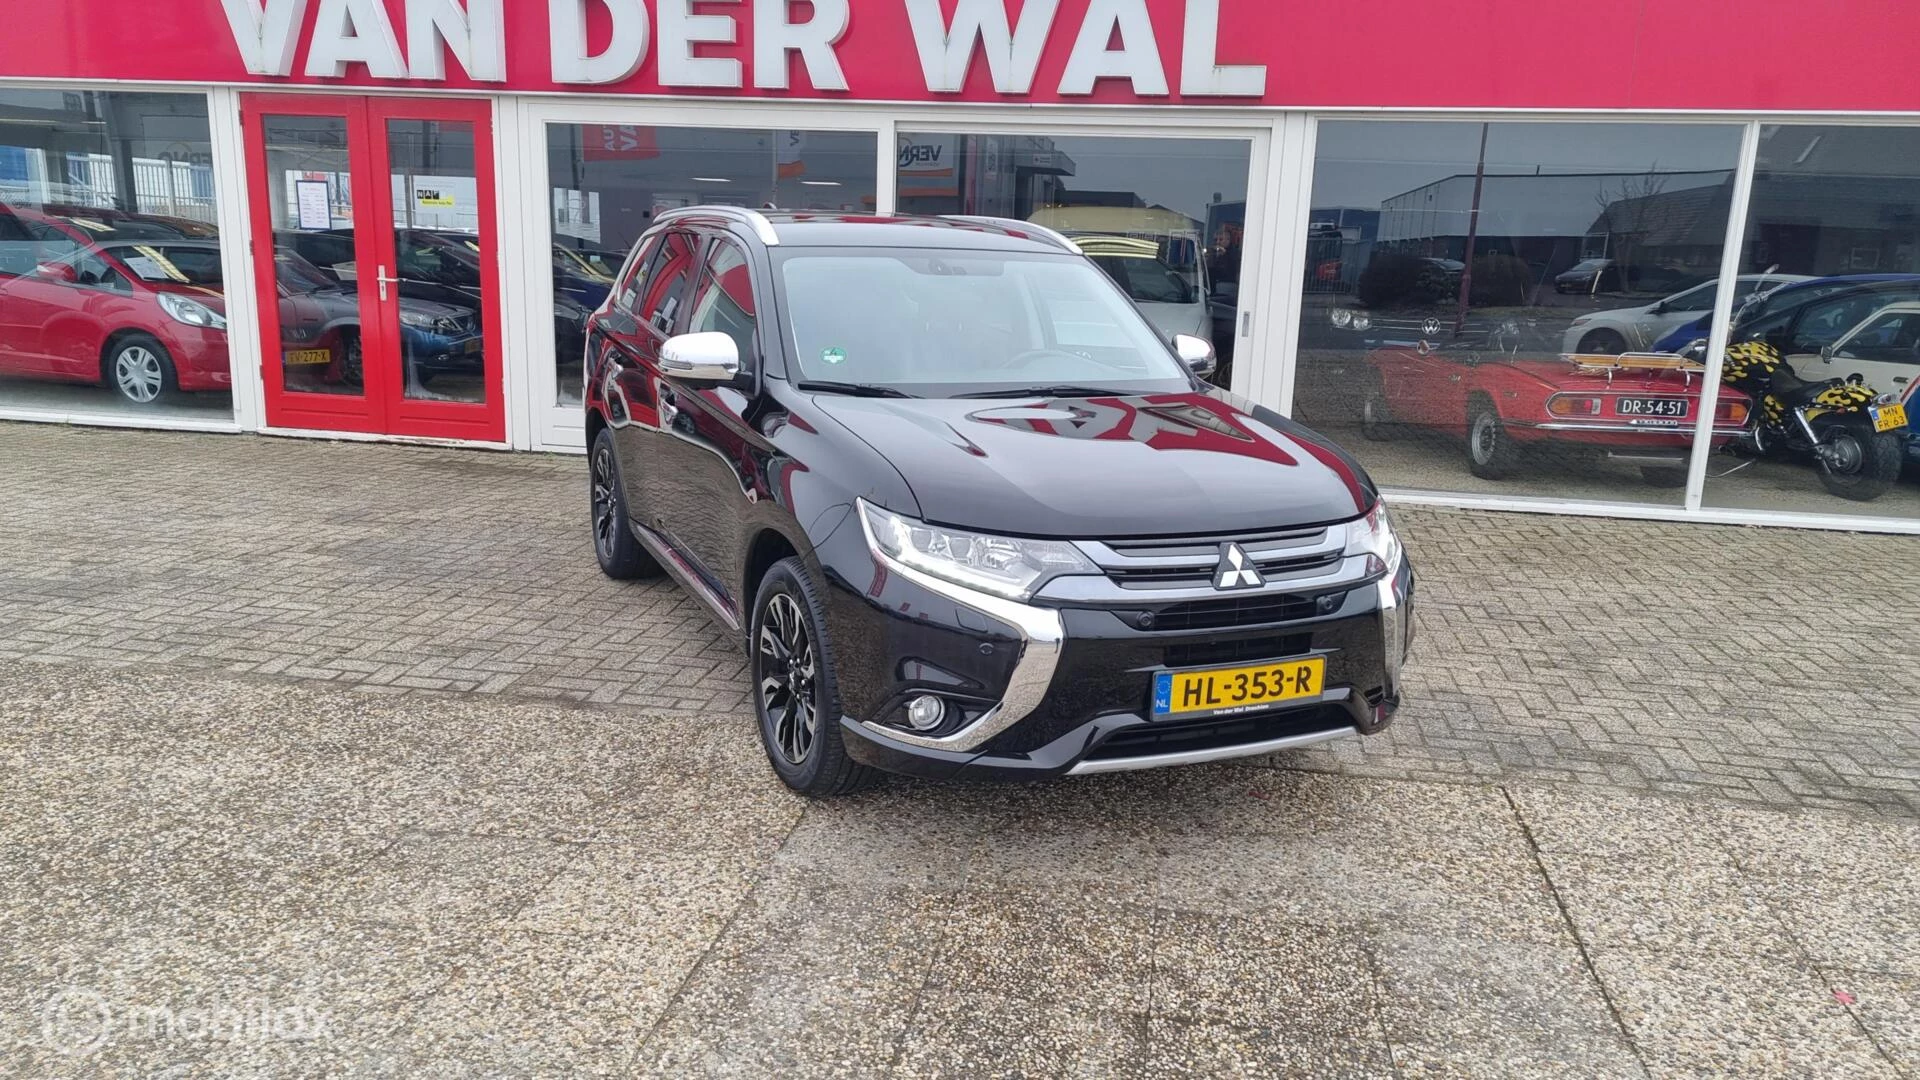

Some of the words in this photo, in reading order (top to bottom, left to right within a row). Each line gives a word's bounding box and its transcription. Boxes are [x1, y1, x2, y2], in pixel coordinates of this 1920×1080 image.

[220, 0, 506, 82] VAN
[549, 0, 849, 92] DER
[906, 0, 1267, 96] WAL
[1622, 400, 1682, 415] DR-54-51
[1883, 407, 1899, 417] MN
[1182, 666, 1312, 707] HL-353-R
[1155, 699, 1169, 709] NL
